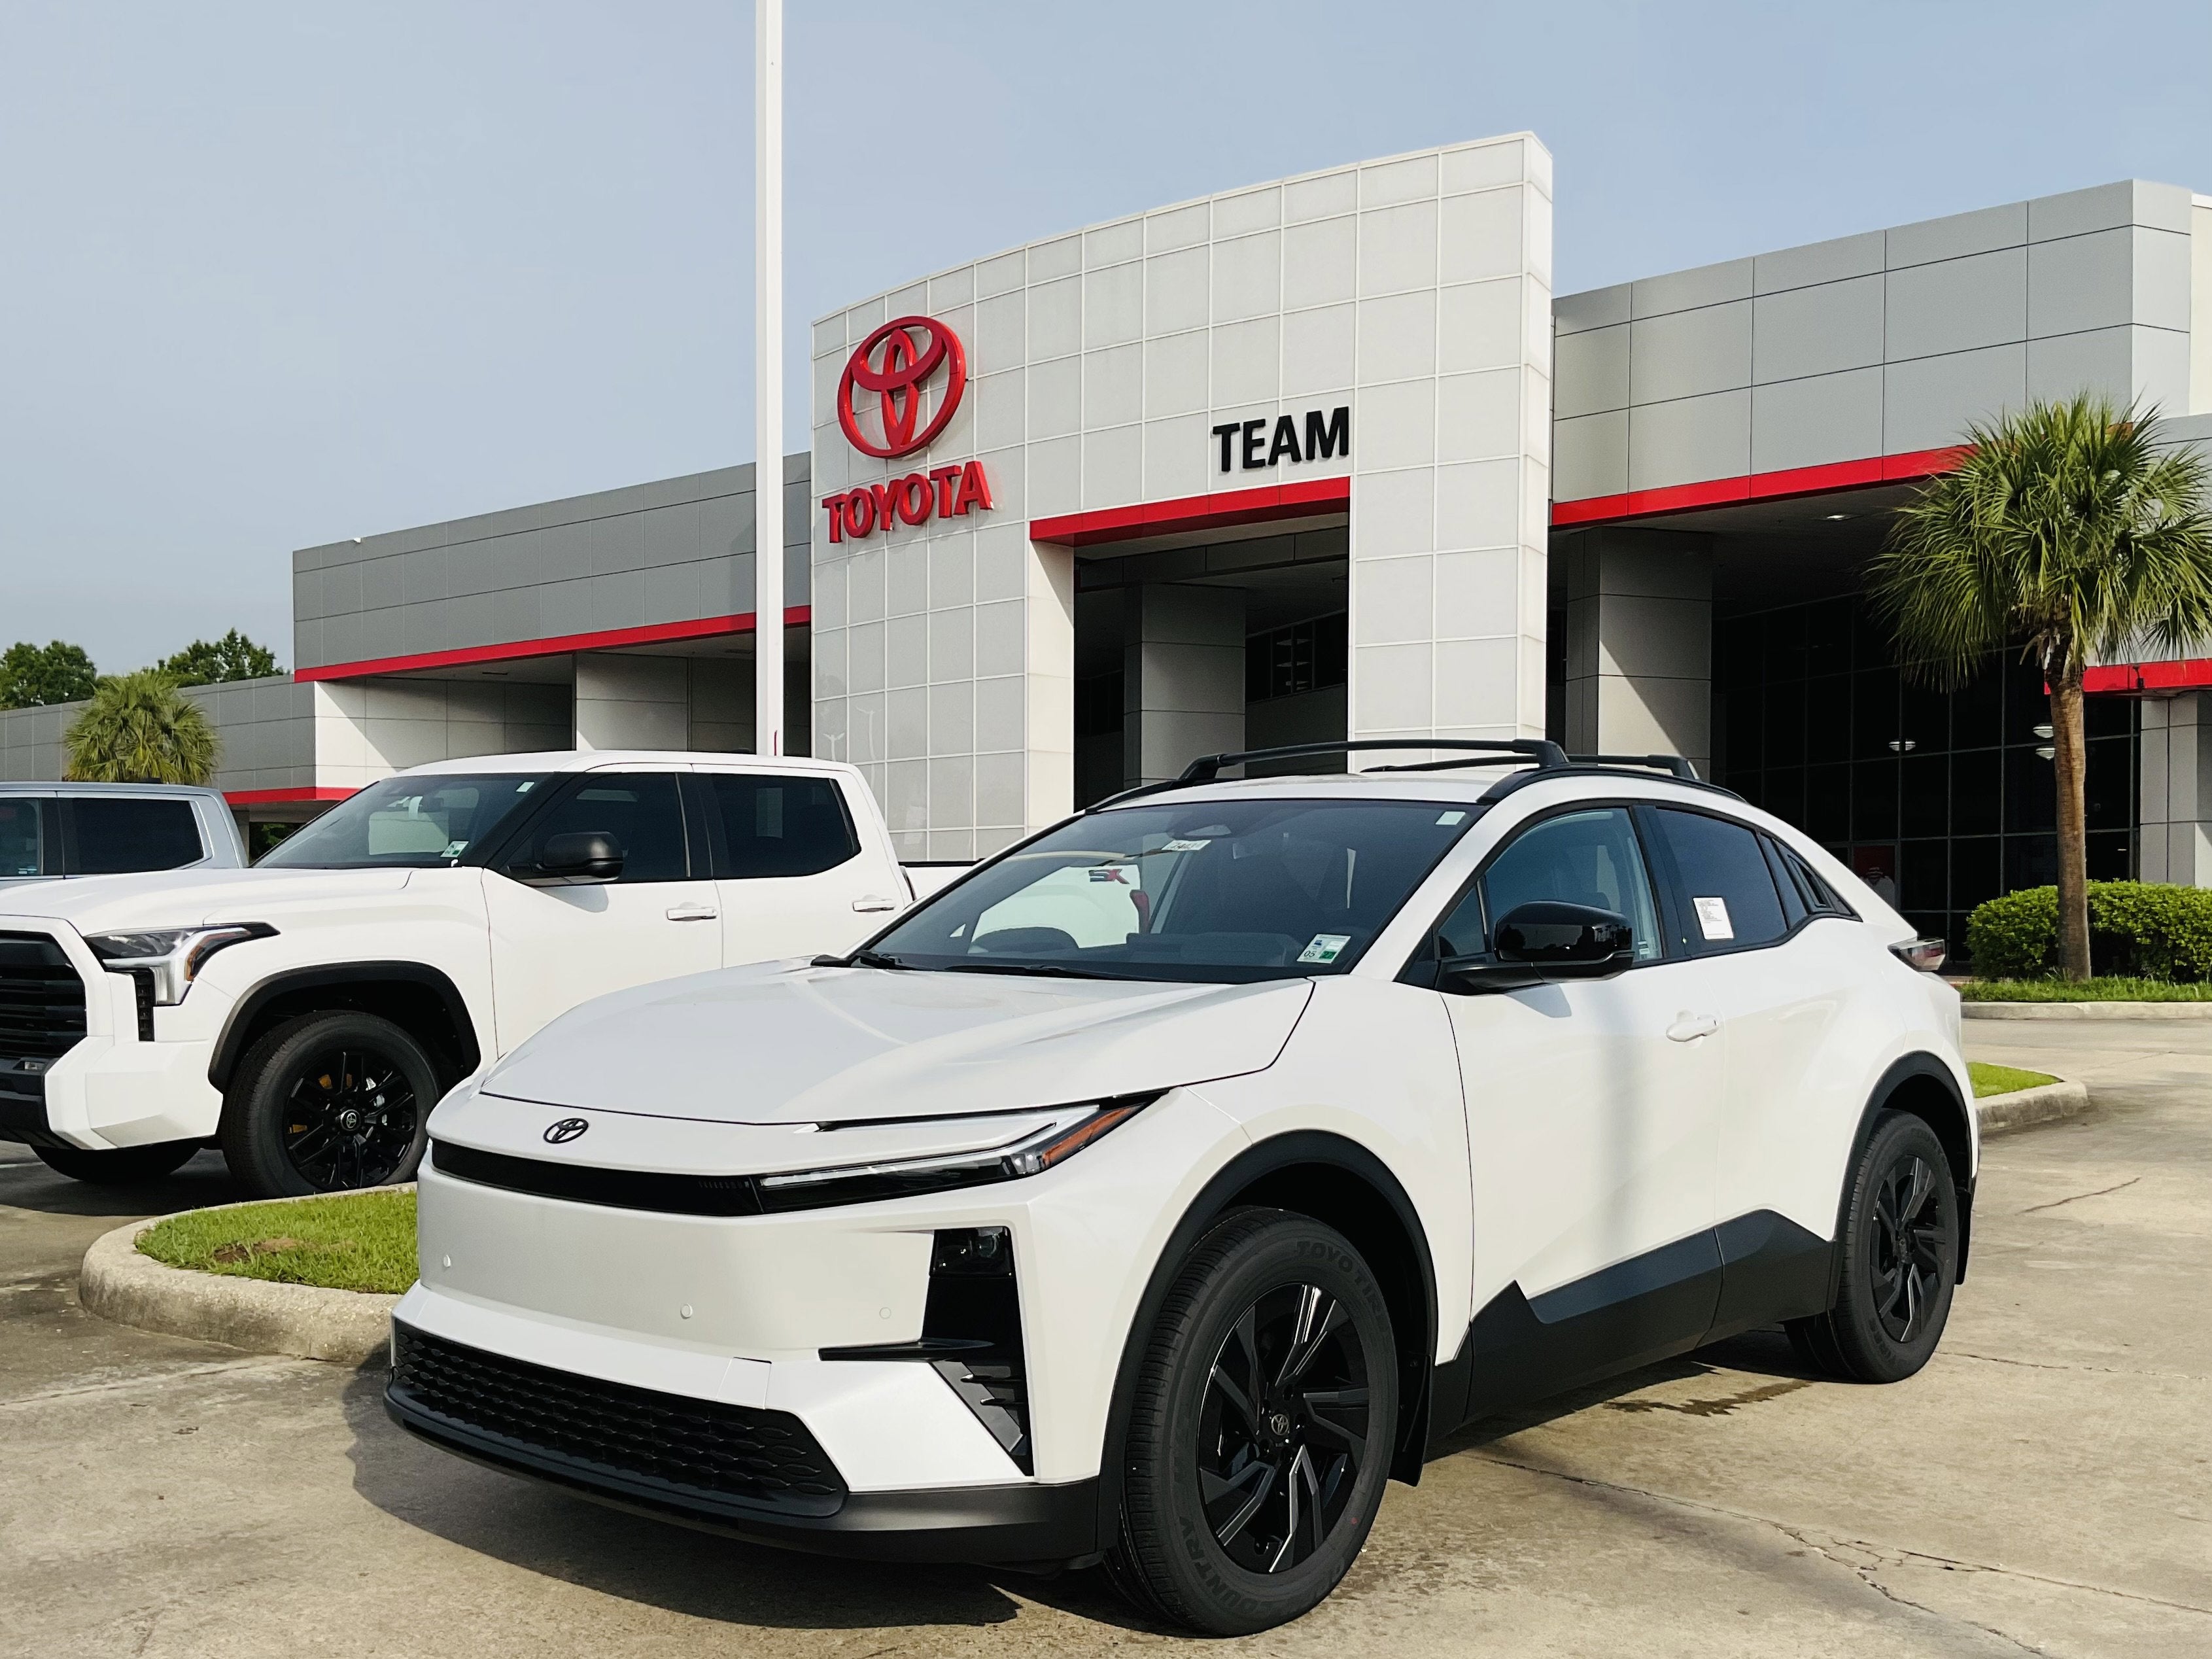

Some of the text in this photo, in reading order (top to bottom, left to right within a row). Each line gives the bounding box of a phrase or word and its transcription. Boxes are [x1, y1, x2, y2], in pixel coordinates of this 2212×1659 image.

[1213, 406, 1349, 472] TEAM
[822, 461, 994, 543] TOYOTA
[1296, 1240, 1354, 1274] TOYO
